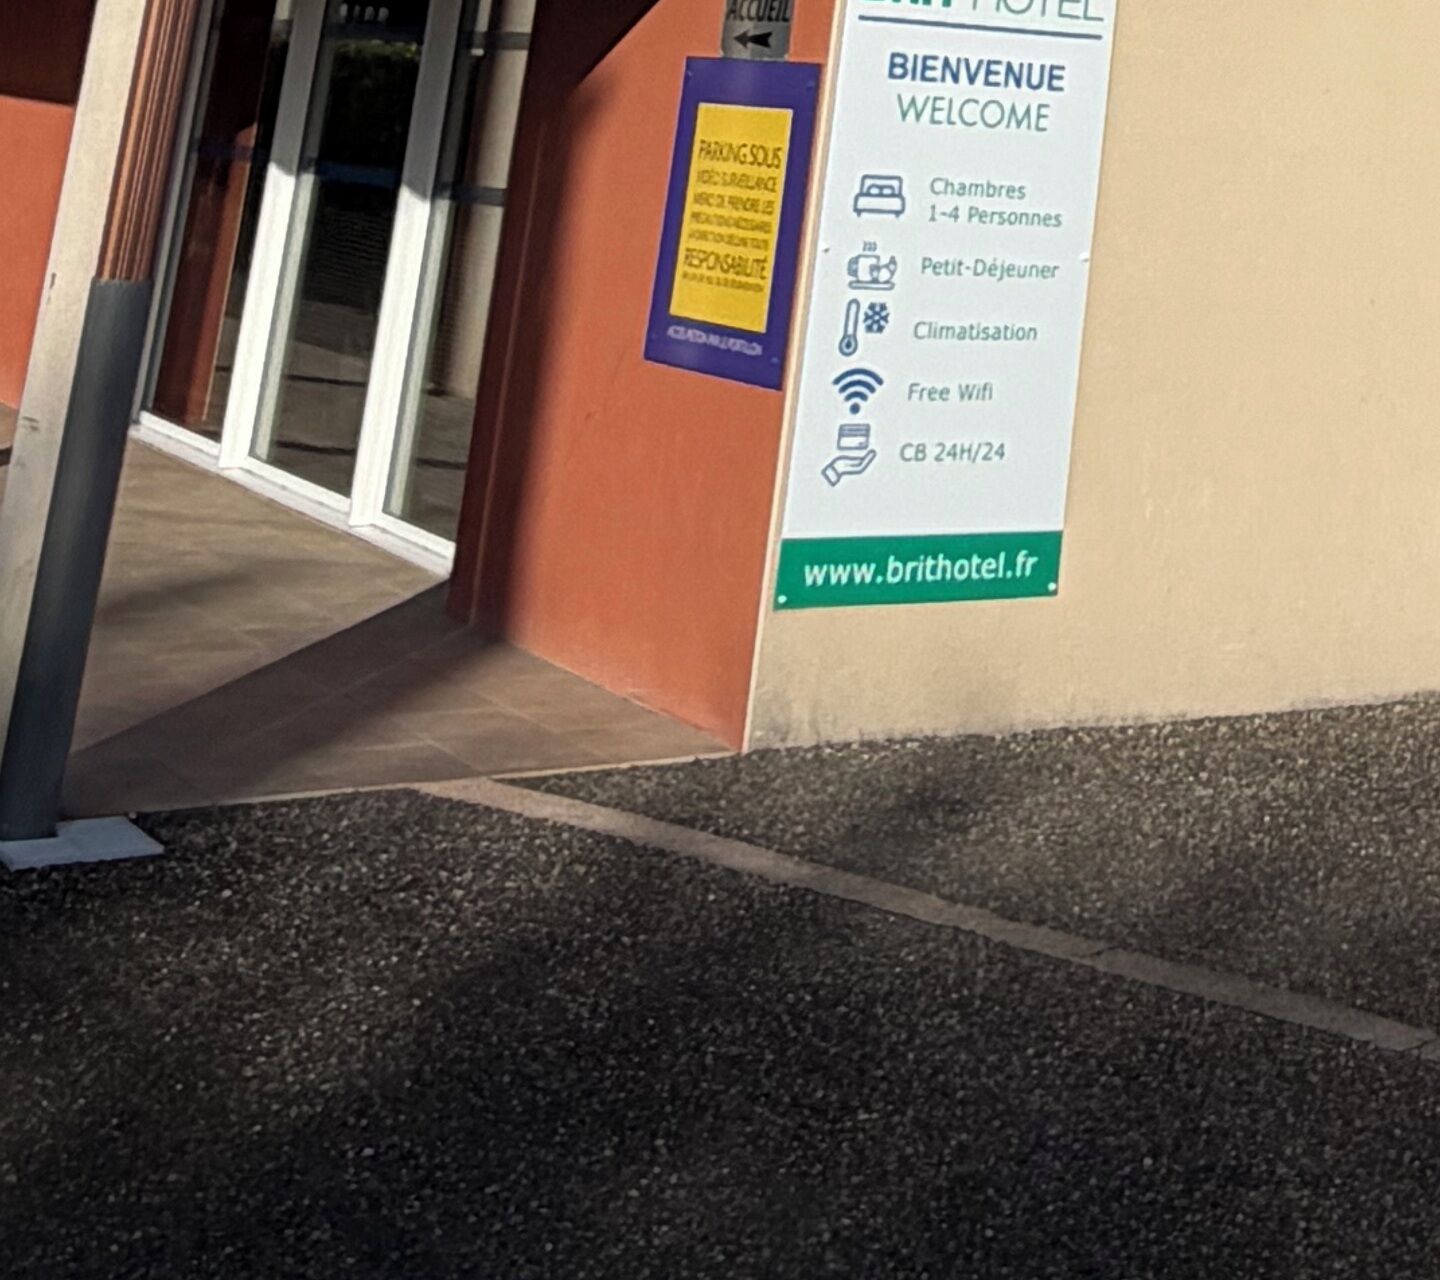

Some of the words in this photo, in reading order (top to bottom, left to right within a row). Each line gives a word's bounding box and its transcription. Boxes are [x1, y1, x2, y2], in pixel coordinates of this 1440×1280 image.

[887, 51, 1065, 92] BIENVENUE
[897, 93, 1050, 133] WELCOME
[698, 139, 747, 165] PARKING
[748, 143, 783, 169] SOUS
[929, 177, 1026, 201] Chambres
[928, 204, 960, 223] 1-4
[967, 205, 1063, 229] Personnes
[920, 256, 1060, 283] Petit-Déjeuner
[913, 320, 1038, 342] Climatisation
[907, 382, 951, 403] Free
[957, 382, 994, 403] Wifi
[899, 442, 927, 463] CB
[933, 442, 1006, 464] 24H/24
[803, 549, 1039, 587] www.brithotel.fr
